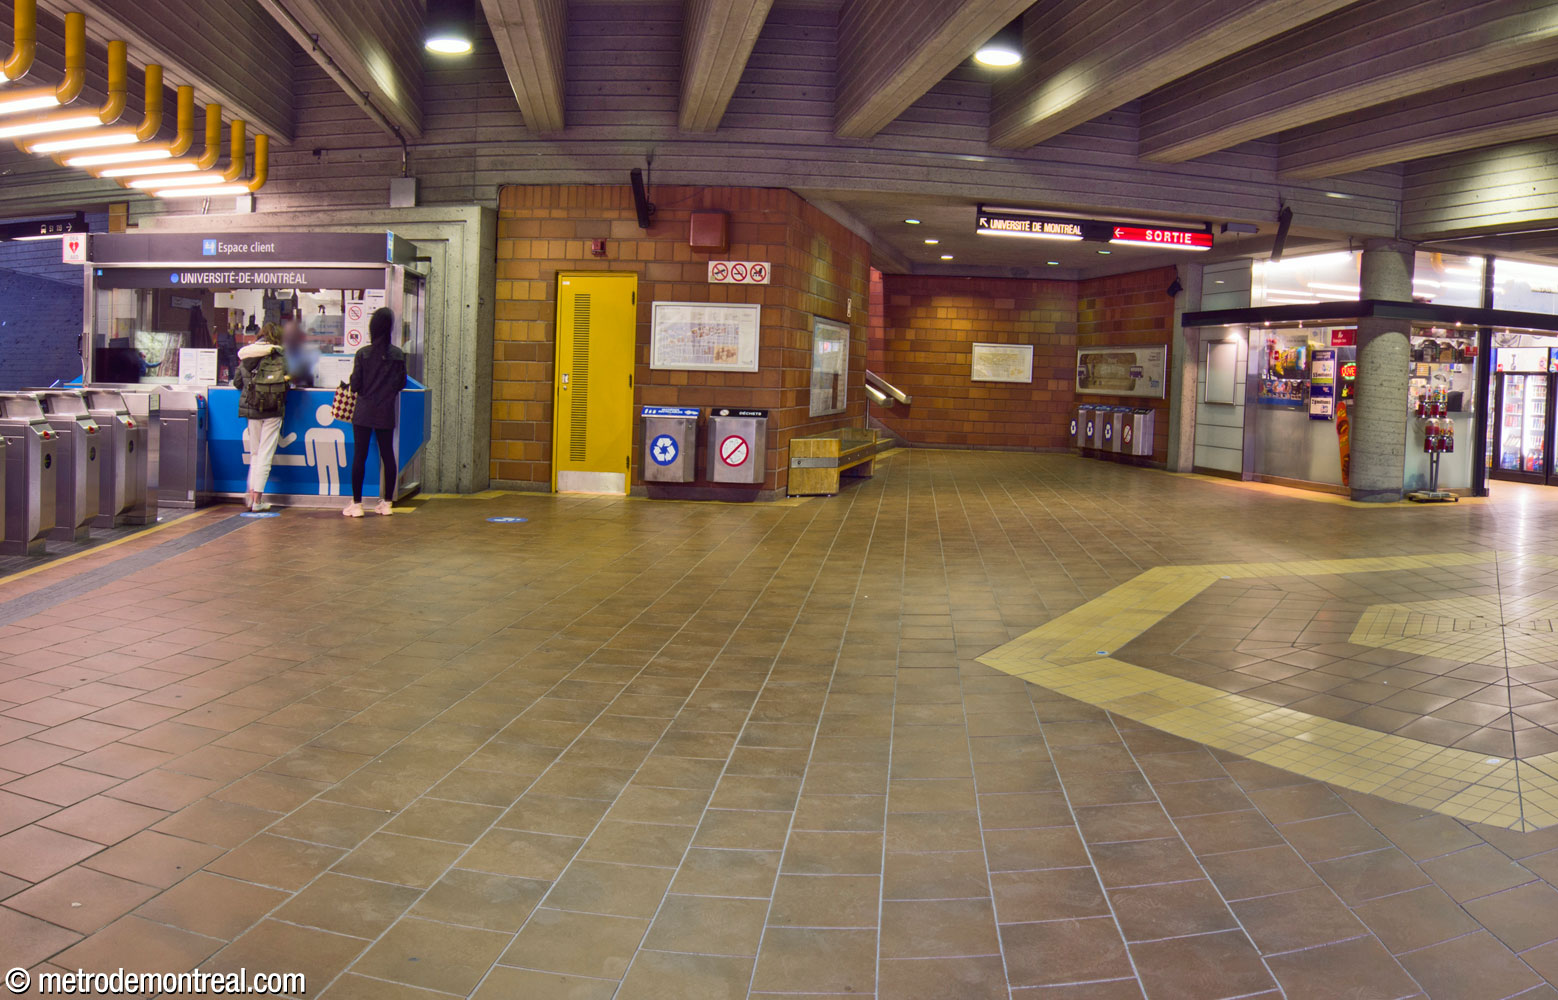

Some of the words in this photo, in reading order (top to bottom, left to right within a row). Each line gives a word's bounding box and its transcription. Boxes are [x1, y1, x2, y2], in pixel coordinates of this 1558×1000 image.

[989, 218, 1030, 232] UNIVERSITÉ
[1032, 222, 1043, 232] DE
[1044, 223, 1082, 235] MONTRÉAL
[1145, 230, 1192, 244] SORTIE
[218, 242, 248, 255] Espace
[250, 241, 275, 253] client
[180, 271, 308, 284] UNIVERSITÉ-DE-MONTRÉAL
